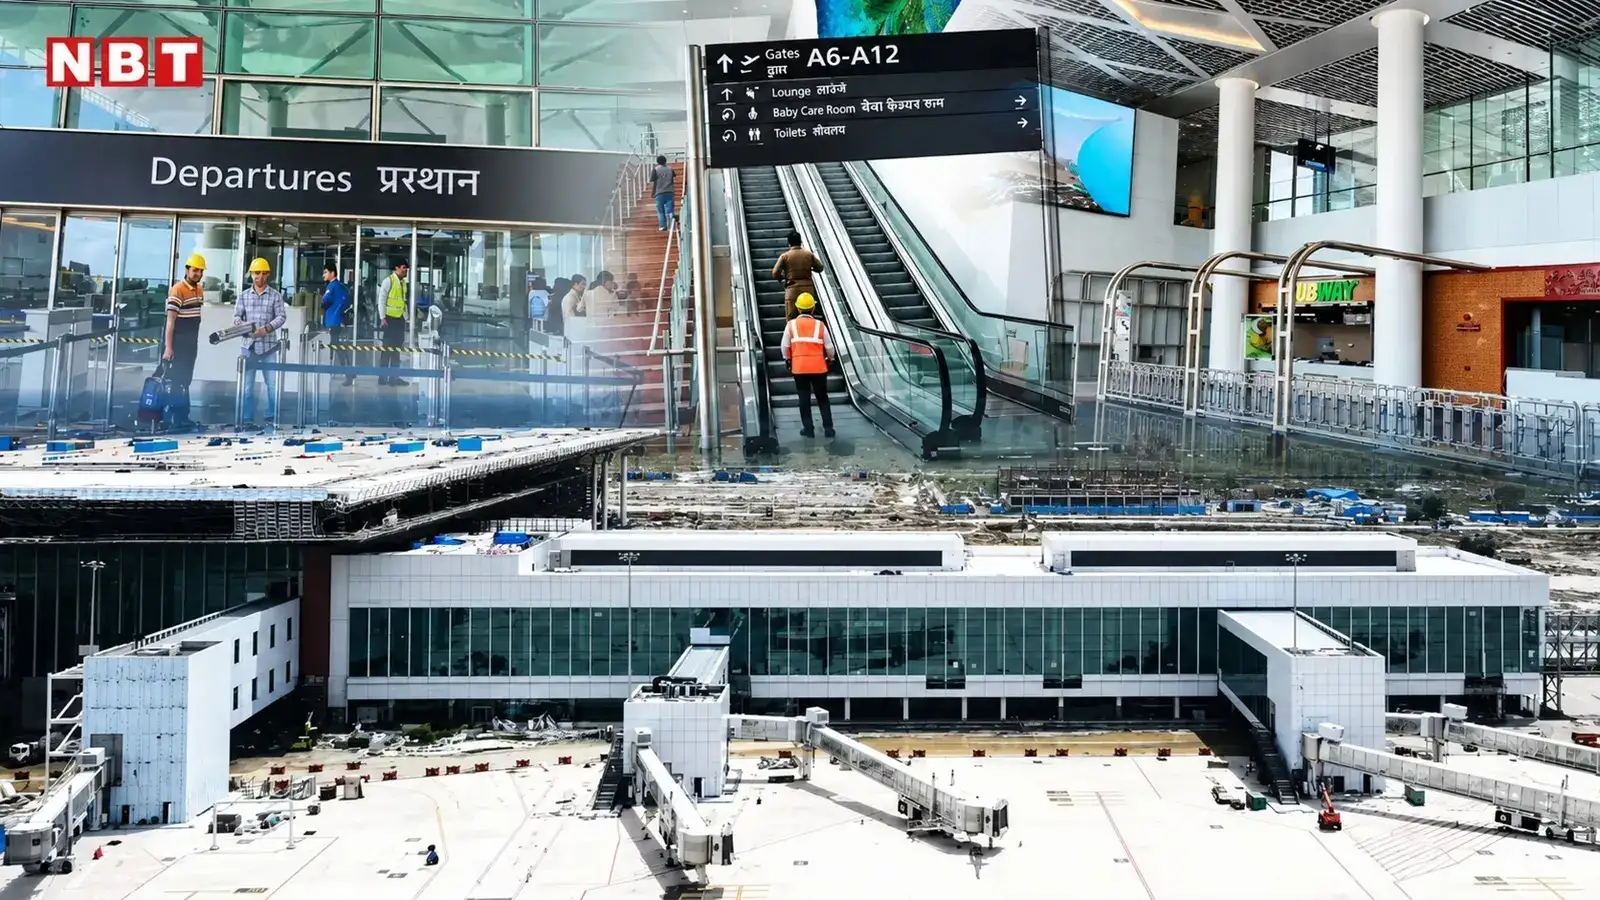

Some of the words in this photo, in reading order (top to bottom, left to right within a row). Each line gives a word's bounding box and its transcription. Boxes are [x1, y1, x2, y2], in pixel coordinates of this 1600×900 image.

[765, 48, 800, 60] Gates
[807, 44, 900, 67] A6-A12
[772, 87, 811, 98] Lounge
[773, 107, 799, 118] Baby
[801, 105, 824, 115] Care
[826, 103, 856, 114] Room
[774, 128, 807, 138] Toilets
[150, 157, 352, 195] Departures
[1296, 280, 1357, 302] UBWAY
